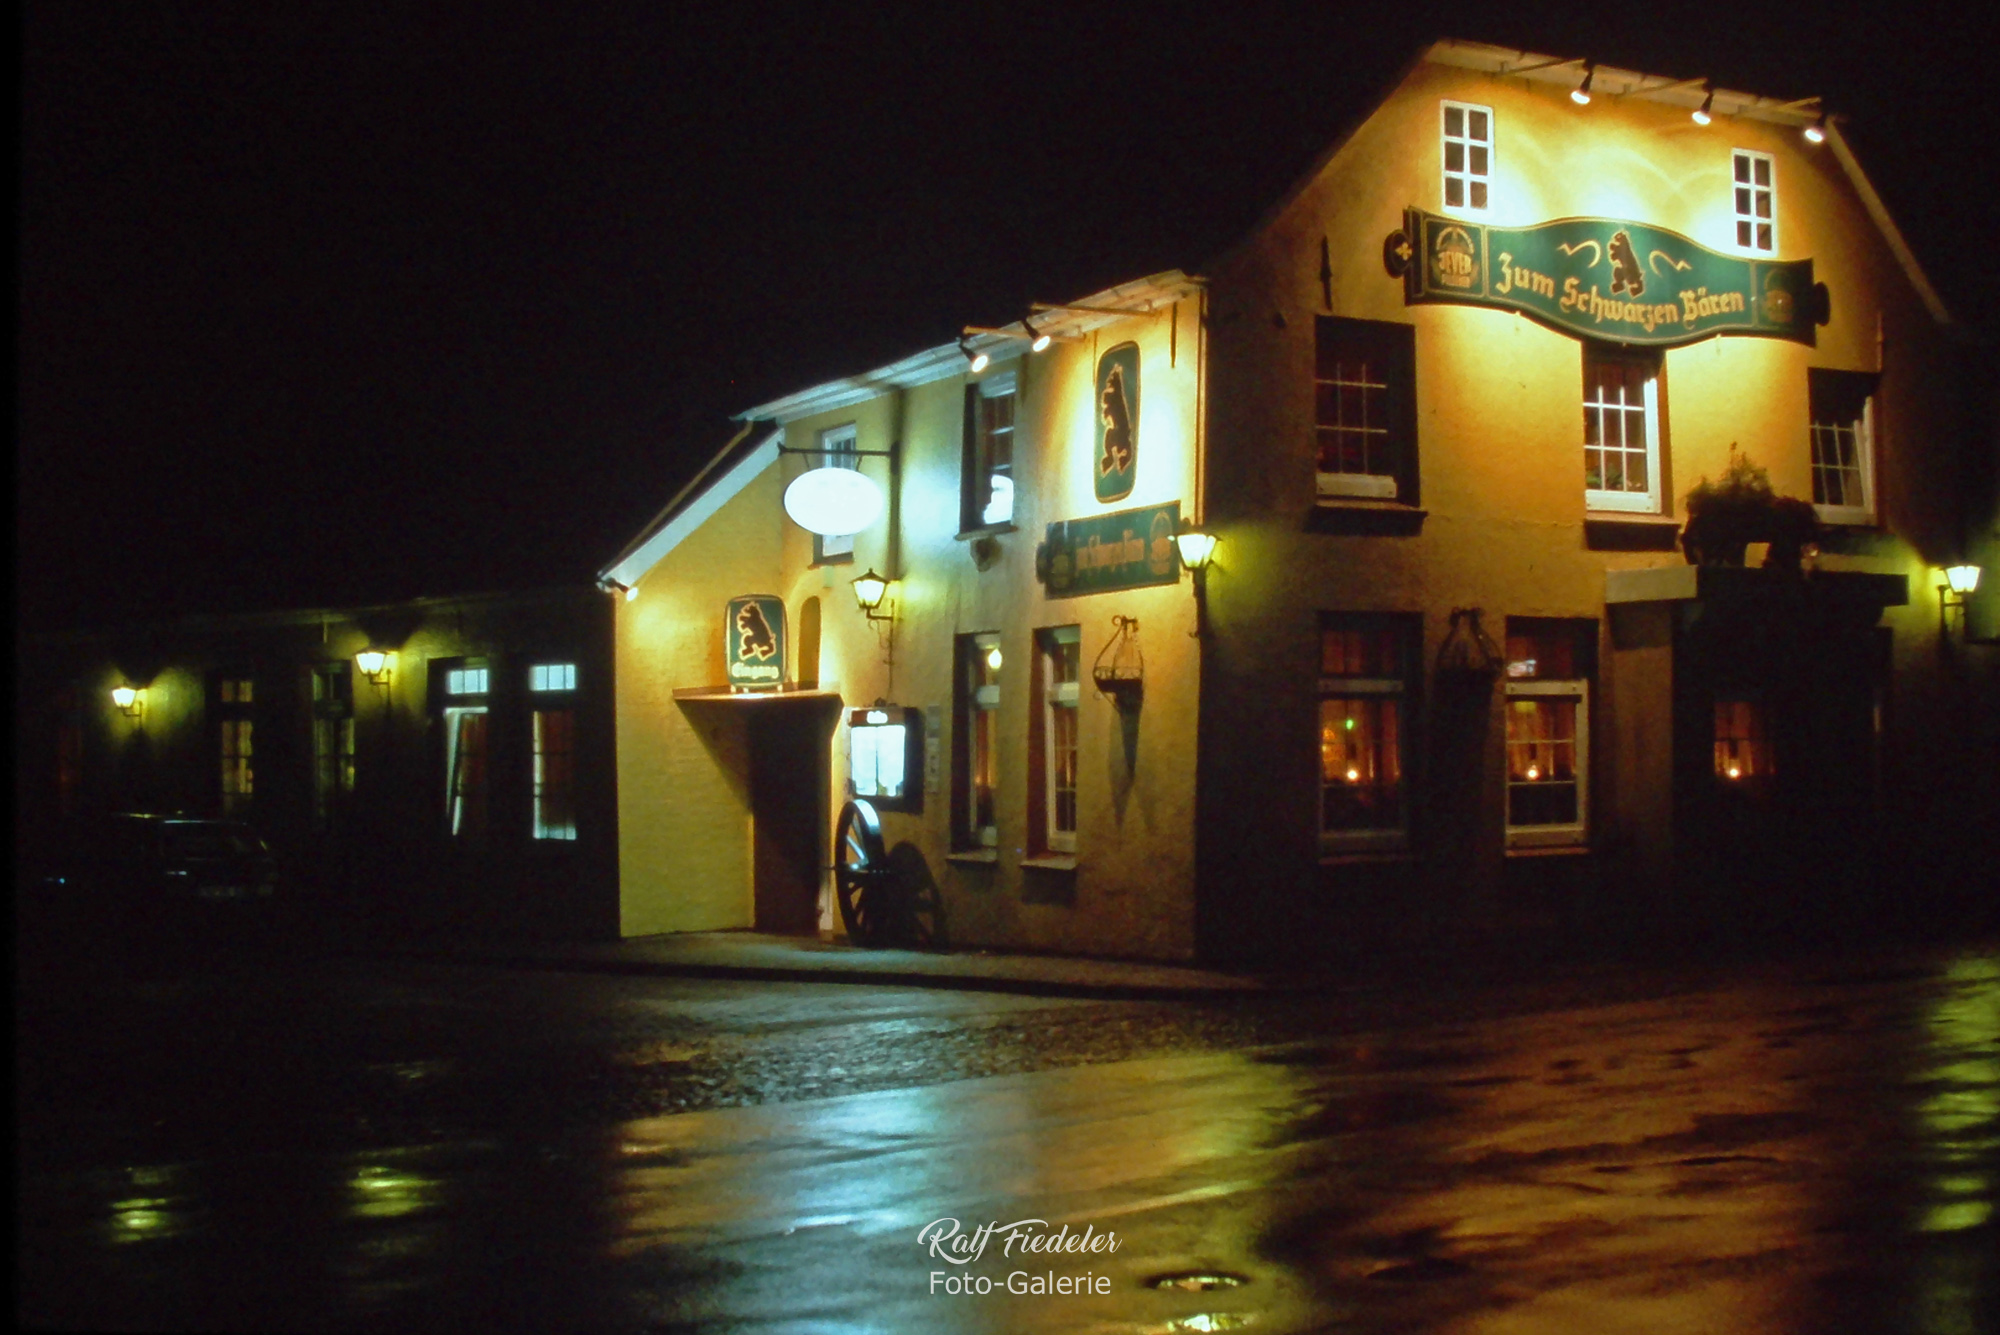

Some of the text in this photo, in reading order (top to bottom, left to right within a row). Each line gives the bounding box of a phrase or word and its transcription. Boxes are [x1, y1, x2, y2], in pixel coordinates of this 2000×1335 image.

[1496, 252, 1554, 298] Zum
[1560, 277, 1679, 332] Schwarzen
[1680, 287, 1745, 329] Bären
